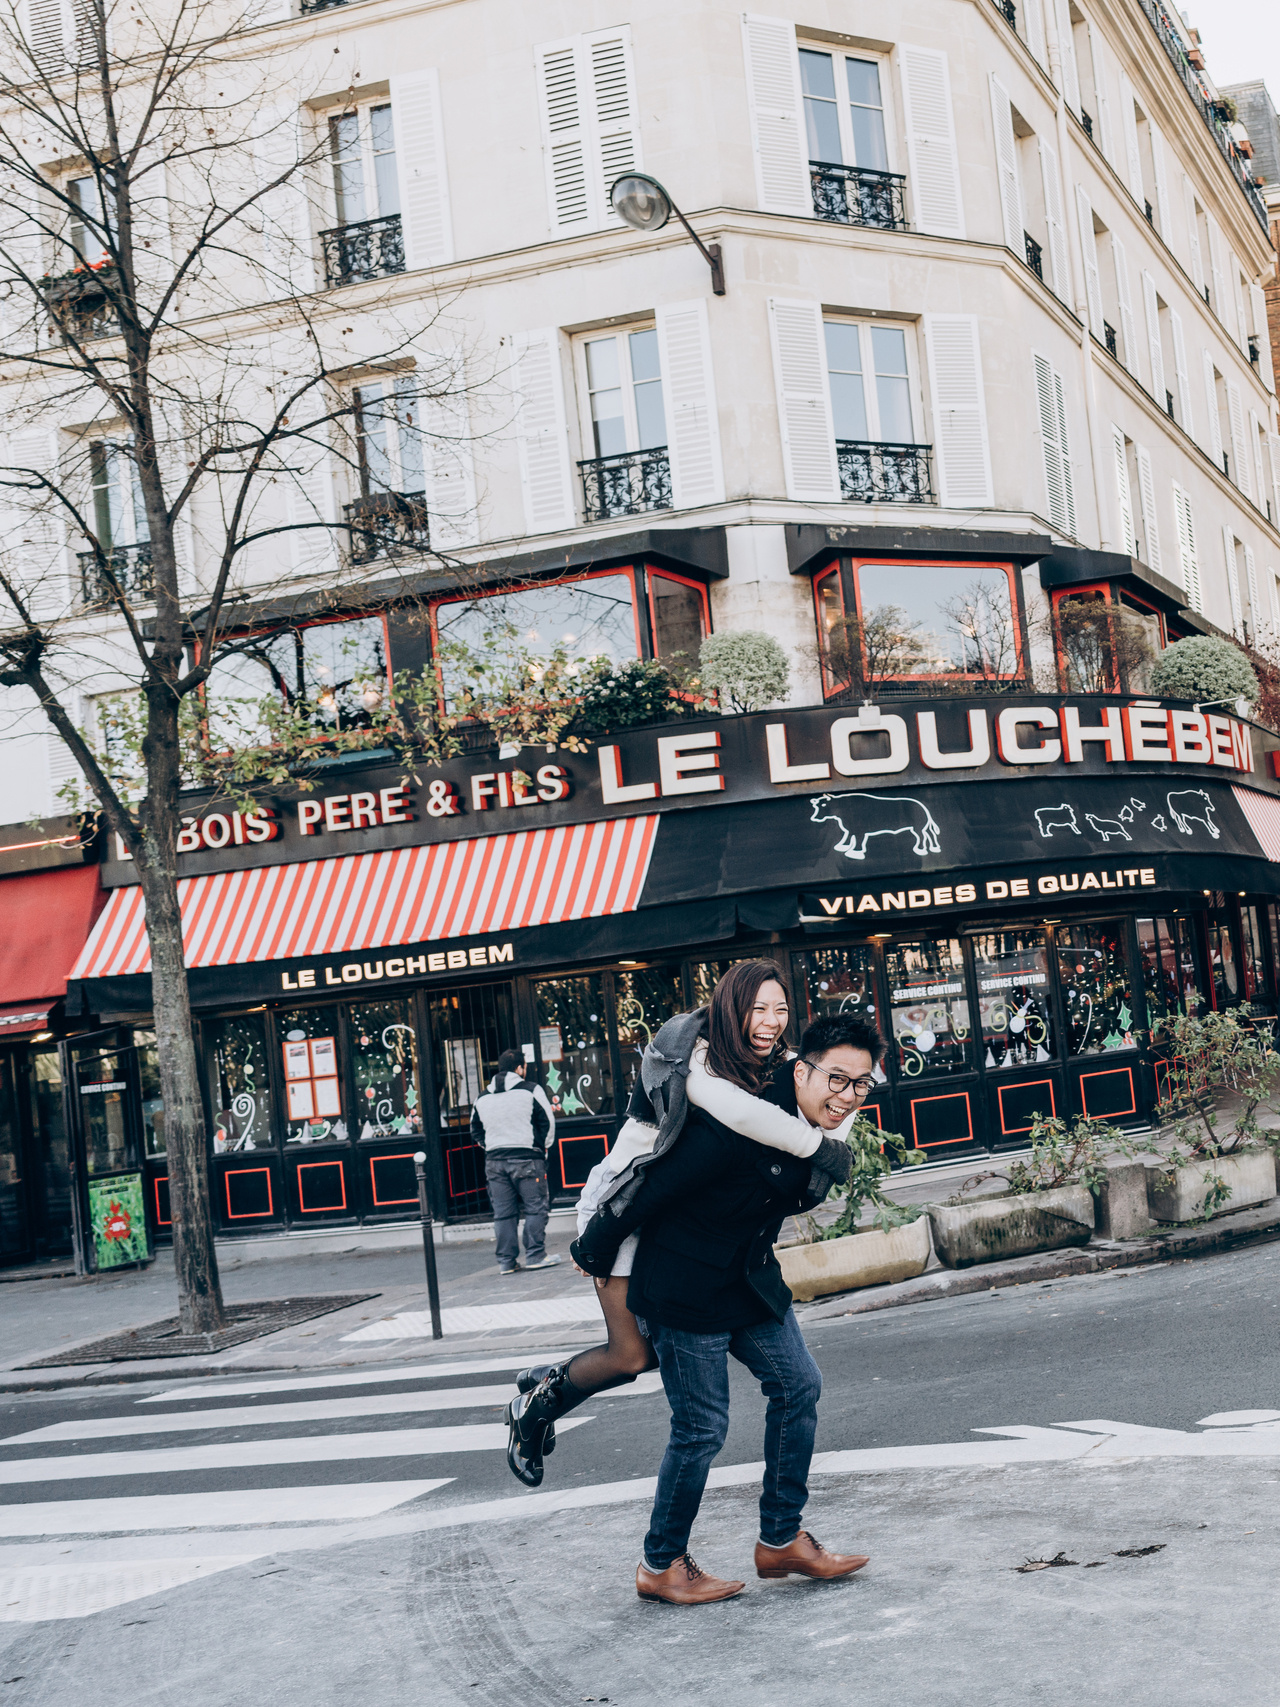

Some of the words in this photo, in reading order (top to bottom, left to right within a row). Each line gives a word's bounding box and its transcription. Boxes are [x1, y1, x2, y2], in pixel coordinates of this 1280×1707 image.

[598, 731, 725, 804] LE
[765, 700, 1256, 784] LOUCHÉBEM
[298, 787, 413, 835] PERE
[426, 779, 459, 817] &
[470, 764, 569, 810] FILS
[819, 884, 976, 915] VIANDES
[986, 879, 1029, 899] DE
[1038, 868, 1156, 893] QUALITE
[281, 969, 316, 990] LE
[325, 943, 514, 985] LOUCHEBEM
[981, 977, 1013, 991] SERVICE
[1013, 973, 1046, 987] CONTINU
[893, 987, 927, 1000] SERVICE
[927, 983, 962, 996] CONTINU
